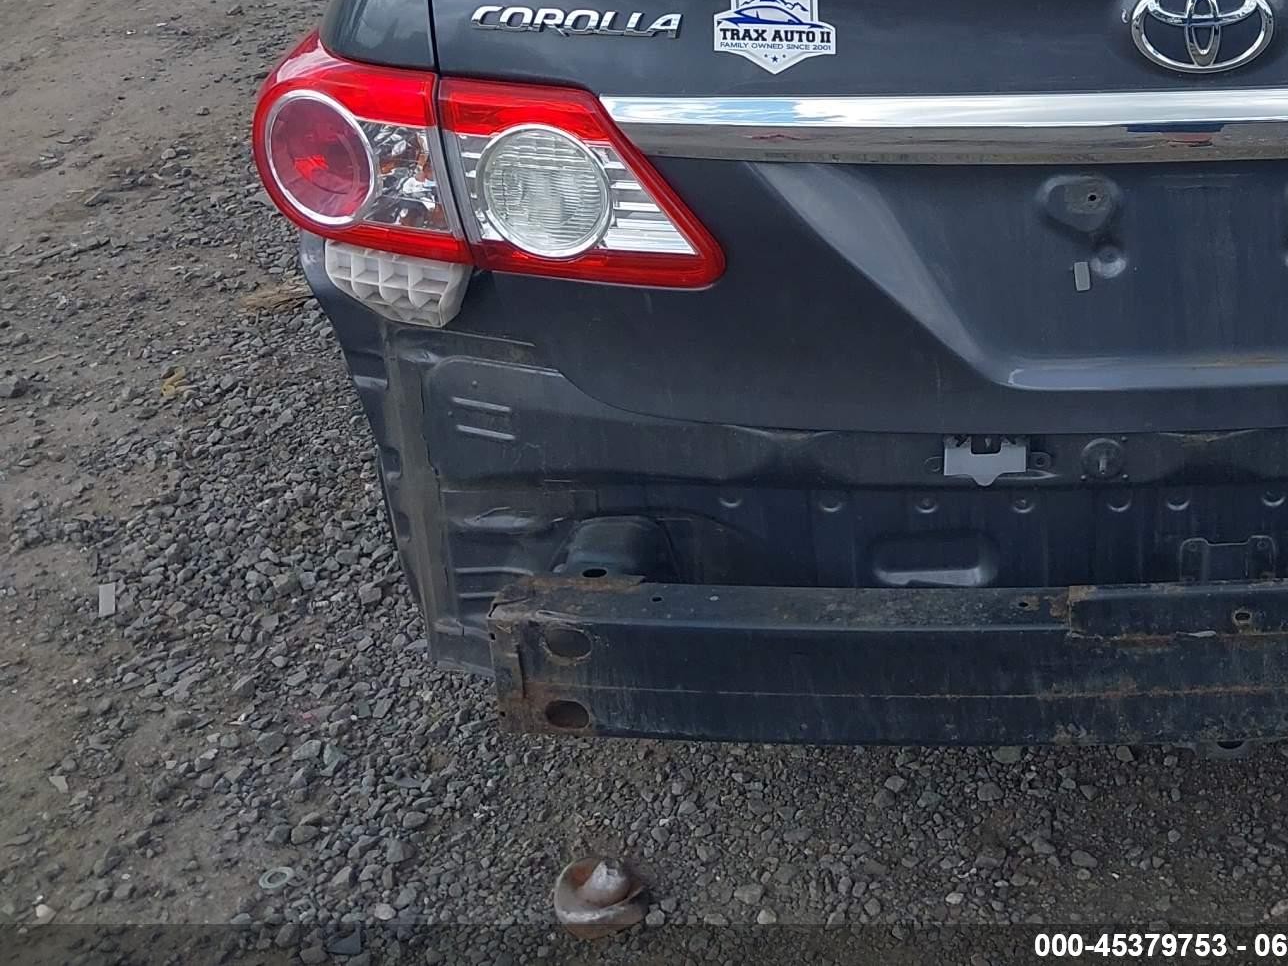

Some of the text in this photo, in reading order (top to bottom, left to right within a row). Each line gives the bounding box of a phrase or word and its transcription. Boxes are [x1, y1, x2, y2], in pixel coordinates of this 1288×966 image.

[471, 5, 683, 39] COROLLA
[719, 27, 832, 44] TRAX AUTO II
[719, 41, 750, 49] FAMILY
[750, 42, 784, 50] OWNED
[786, 43, 811, 51] SINCE
